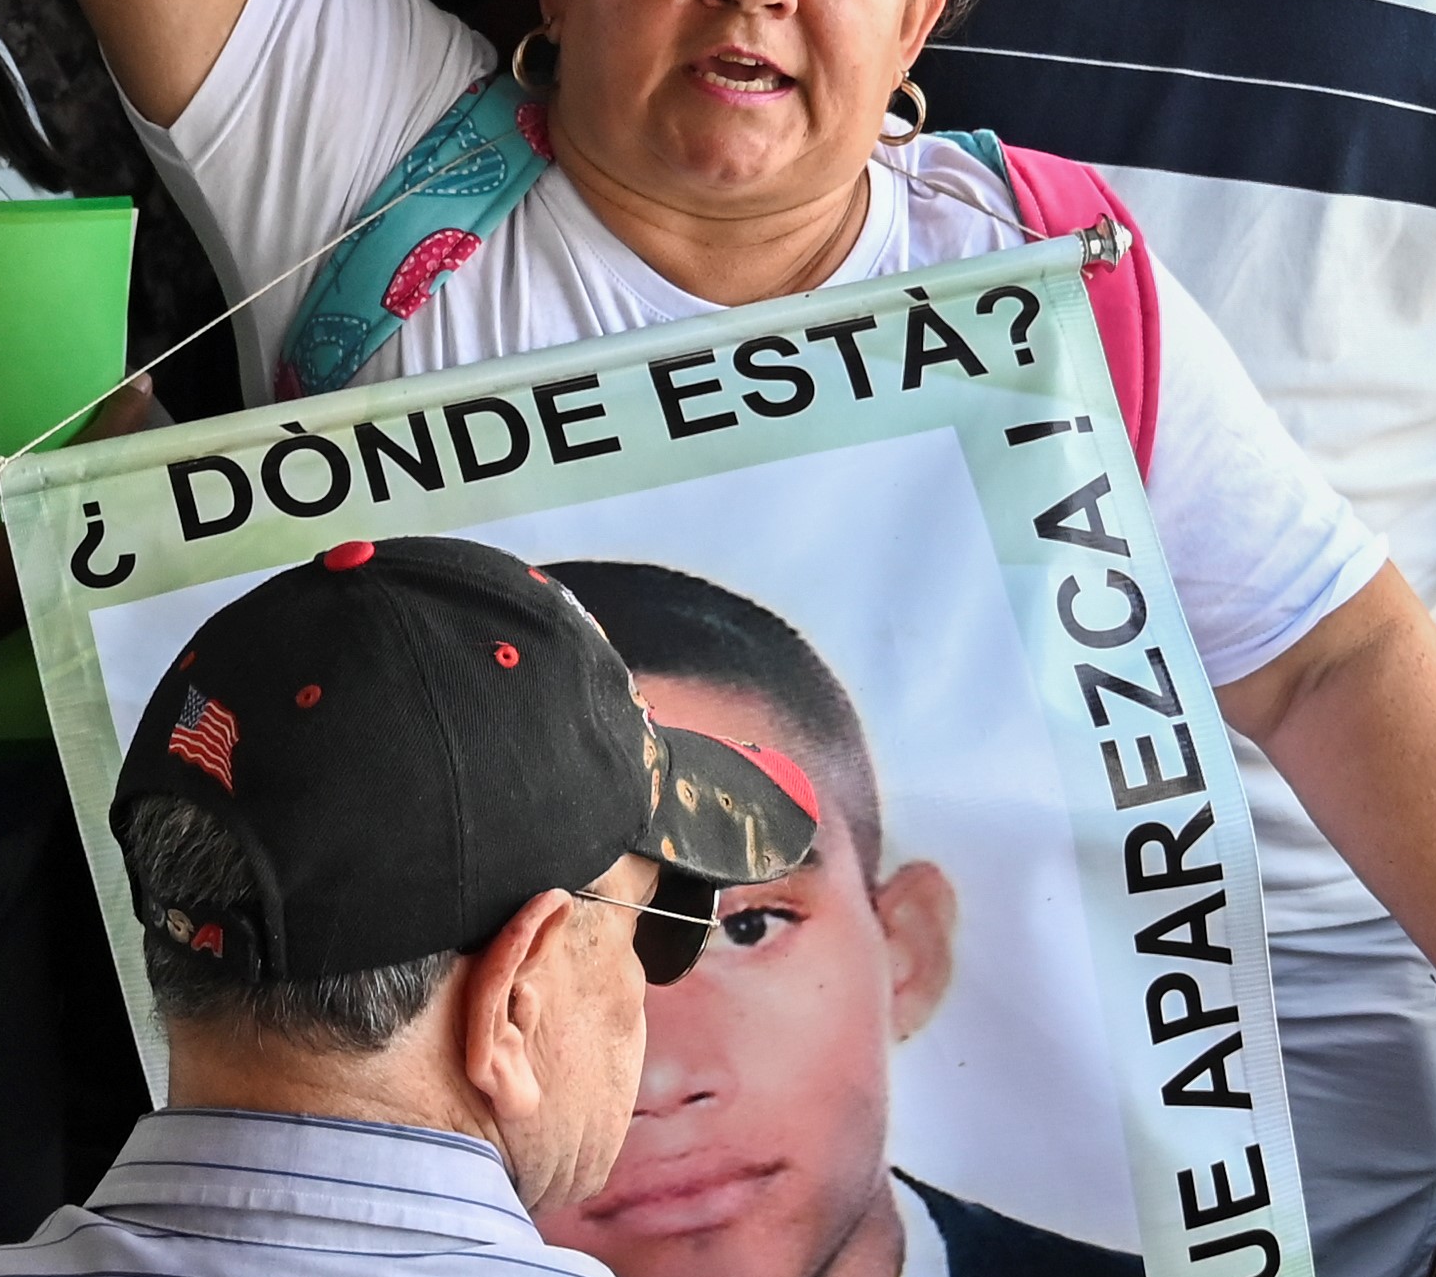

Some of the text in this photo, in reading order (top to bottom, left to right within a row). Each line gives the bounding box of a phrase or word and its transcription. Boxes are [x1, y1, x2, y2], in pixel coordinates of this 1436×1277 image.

[71, 501, 135, 588] ¿
[1033, 472, 1253, 1110] APAREZCA
[152, 903, 224, 958] USA
